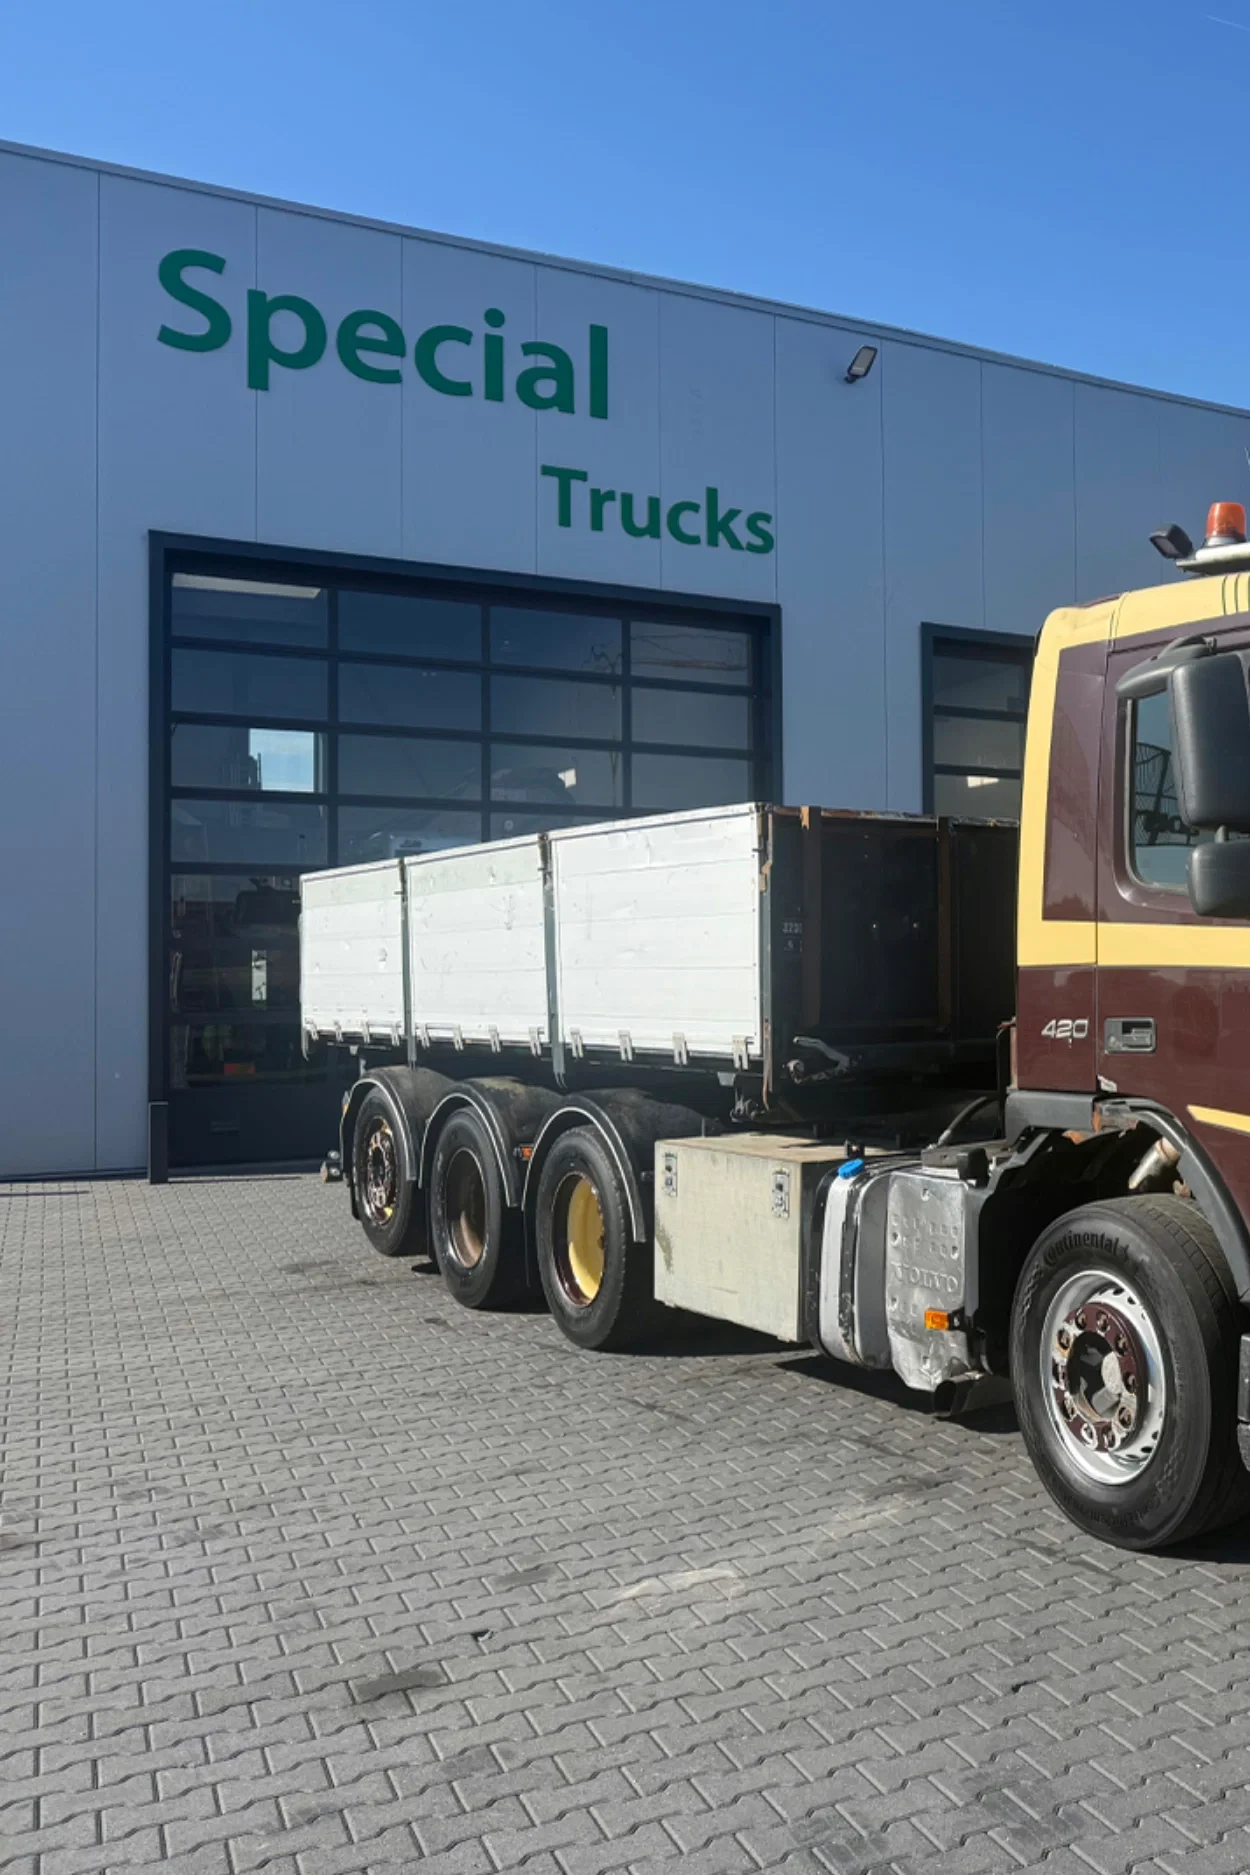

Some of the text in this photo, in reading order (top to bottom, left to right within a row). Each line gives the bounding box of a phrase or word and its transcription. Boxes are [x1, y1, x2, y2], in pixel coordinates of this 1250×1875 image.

[156, 247, 609, 420] Special
[540, 464, 776, 555] Trucks
[1041, 1018, 1089, 1038] 420
[1043, 1230, 1121, 1267] Continental
